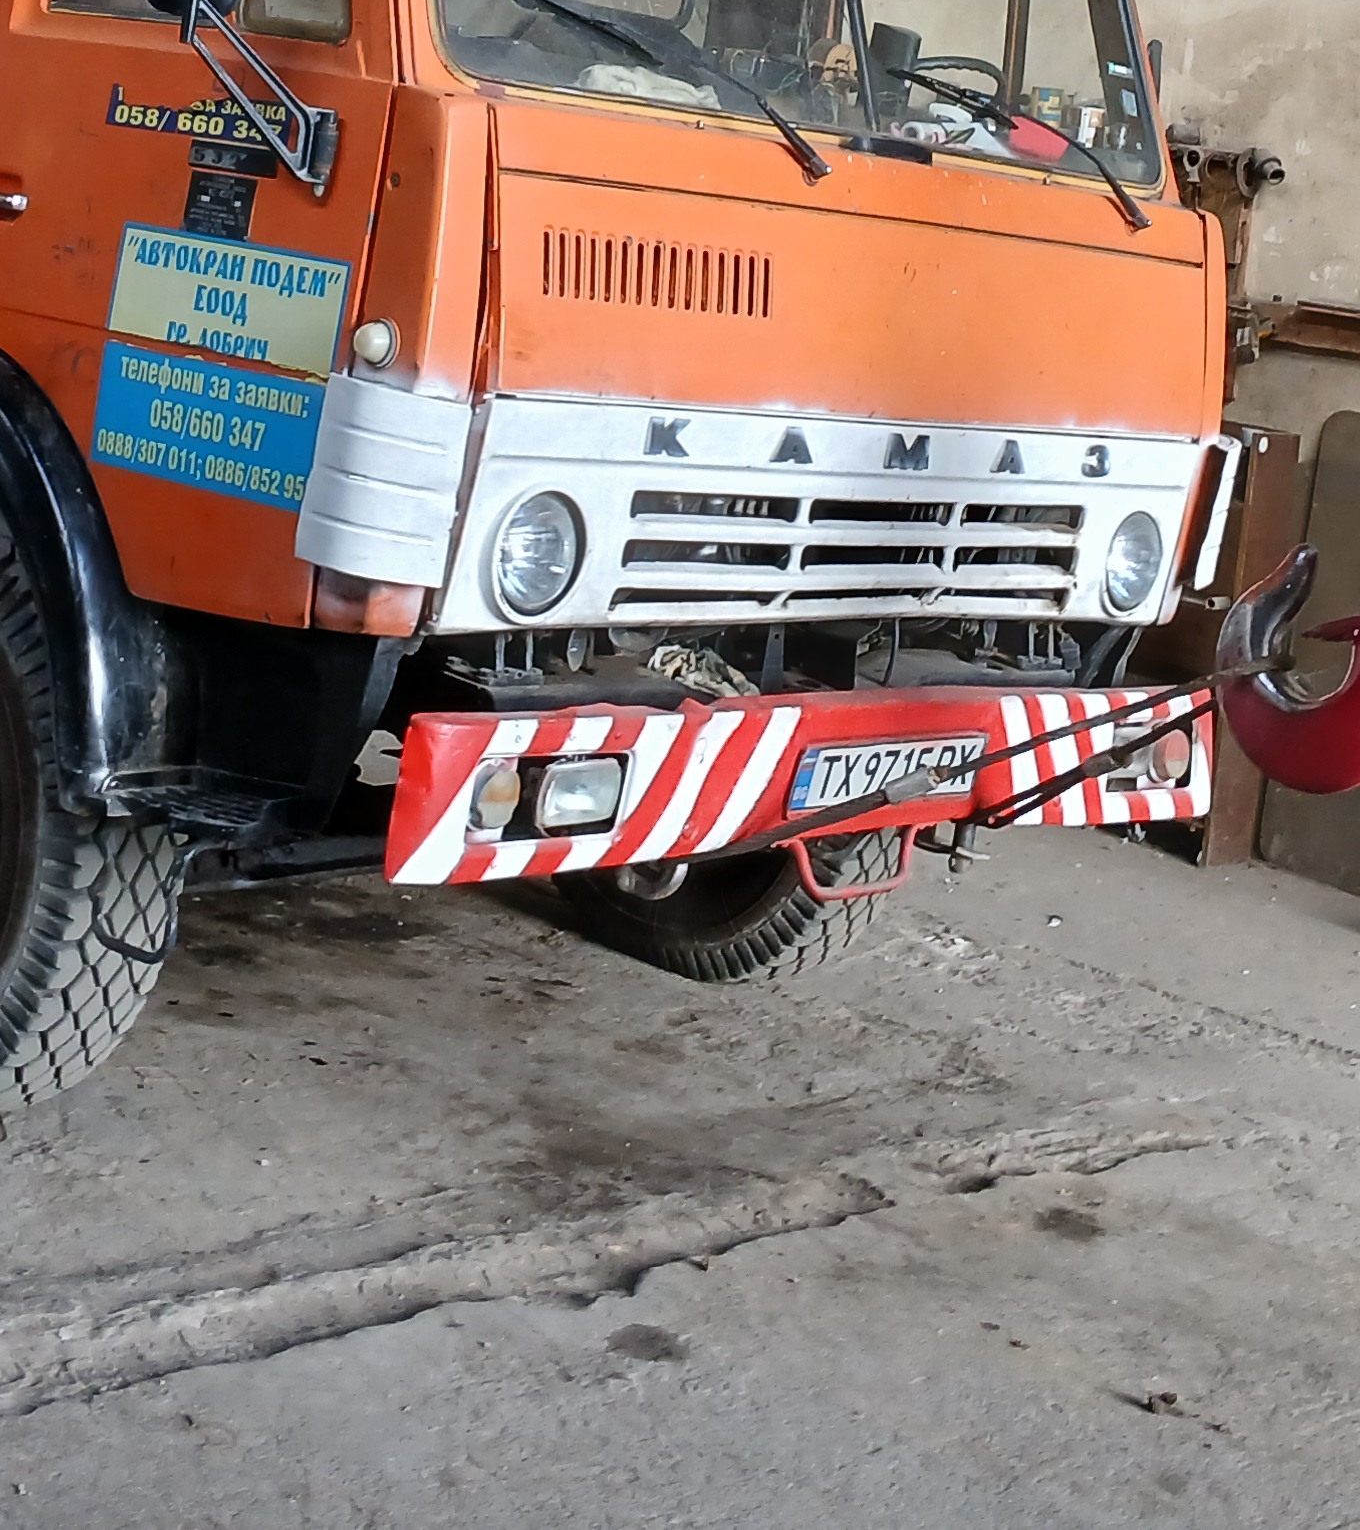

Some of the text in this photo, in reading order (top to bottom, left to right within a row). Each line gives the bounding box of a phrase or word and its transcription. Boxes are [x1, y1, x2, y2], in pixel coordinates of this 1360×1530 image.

[115, 105, 170, 131] 058/
[177, 113, 225, 136] 660
[221, 100, 286, 121] ЗАВКА
[128, 236, 341, 298] "АВТОКРАН ПОДЕМ"
[194, 284, 248, 327] ЕООД
[120, 356, 205, 394] телефони
[208, 375, 231, 401] за
[150, 398, 266, 452] 058/660 347
[643, 416, 1110, 478] КАМАЗ
[97, 428, 167, 467] 0888/307
[168, 445, 203, 481] 011;
[205, 454, 280, 495] 0886/852
